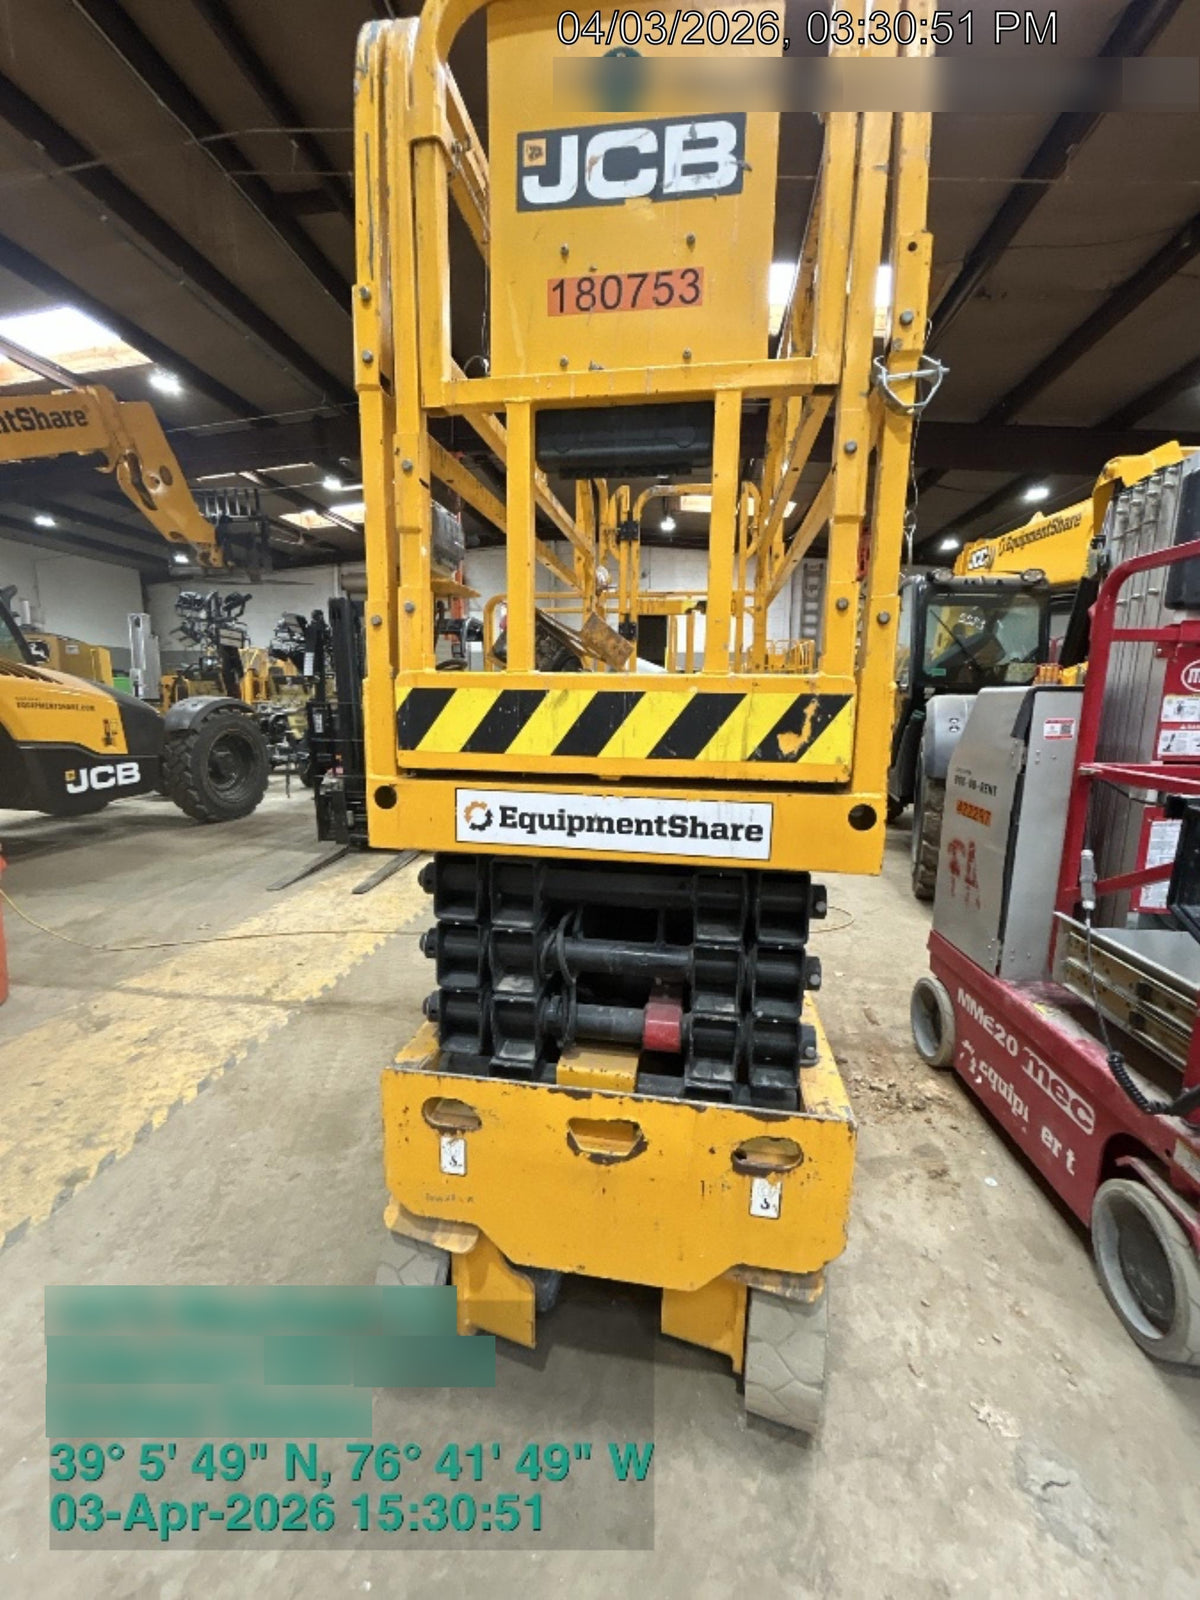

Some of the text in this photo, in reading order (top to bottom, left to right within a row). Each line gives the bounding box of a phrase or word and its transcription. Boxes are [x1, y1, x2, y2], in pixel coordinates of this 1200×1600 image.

[522, 119, 739, 205] JCB
[551, 267, 701, 314] 180753
[66, 762, 141, 794] JCB
[499, 806, 764, 841] EquipmentShare
[958, 988, 1019, 1057] MME20
